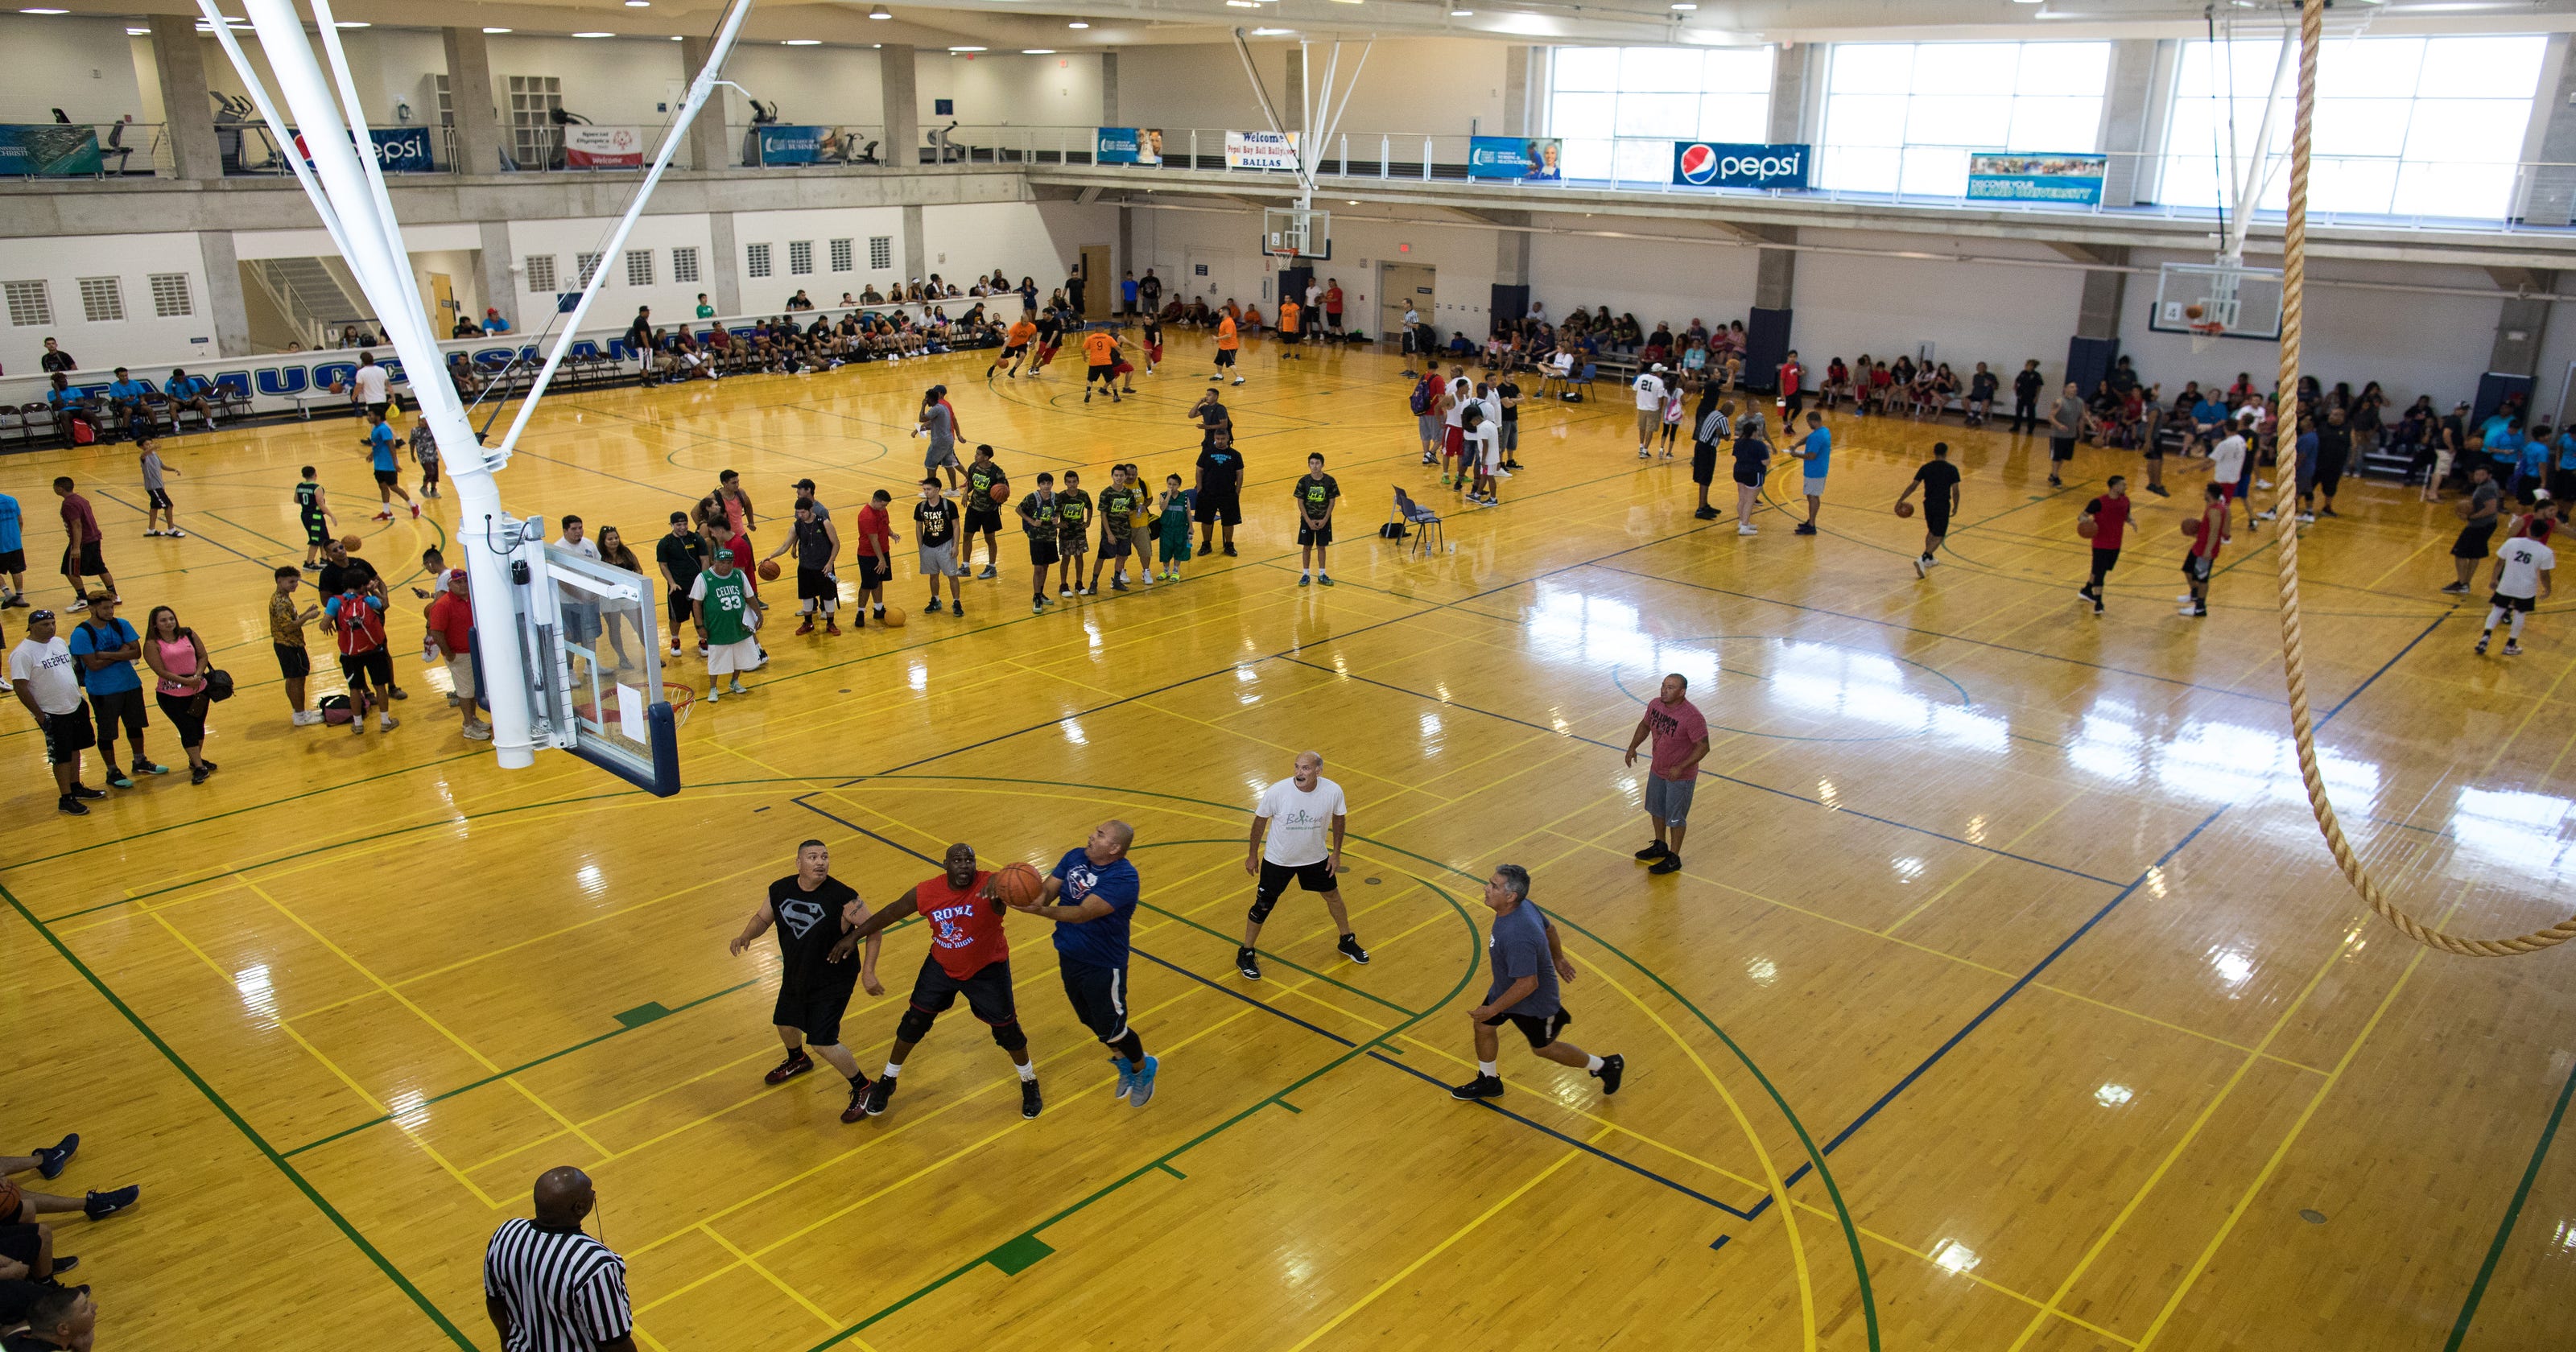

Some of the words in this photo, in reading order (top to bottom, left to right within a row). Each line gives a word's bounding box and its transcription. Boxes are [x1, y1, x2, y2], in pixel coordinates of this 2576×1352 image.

[1243, 132, 1284, 143] Welcome
[1243, 146, 1253, 155] Bay
[1242, 158, 1282, 167] BALLAS
[1720, 152, 1801, 181] pepsi
[2015, 187, 2094, 200] UNIVERSITY
[1273, 236, 1278, 245] 2
[1096, 340, 1103, 351] 9
[1641, 379, 1653, 393] 21
[302, 493, 309, 505] 0
[923, 510, 943, 520] STAY
[2513, 550, 2533, 565] 26
[716, 584, 741, 598] CELTICS
[720, 595, 742, 611] 33
[1286, 809, 1323, 826] Believe
[953, 936, 974, 949] HIGH
